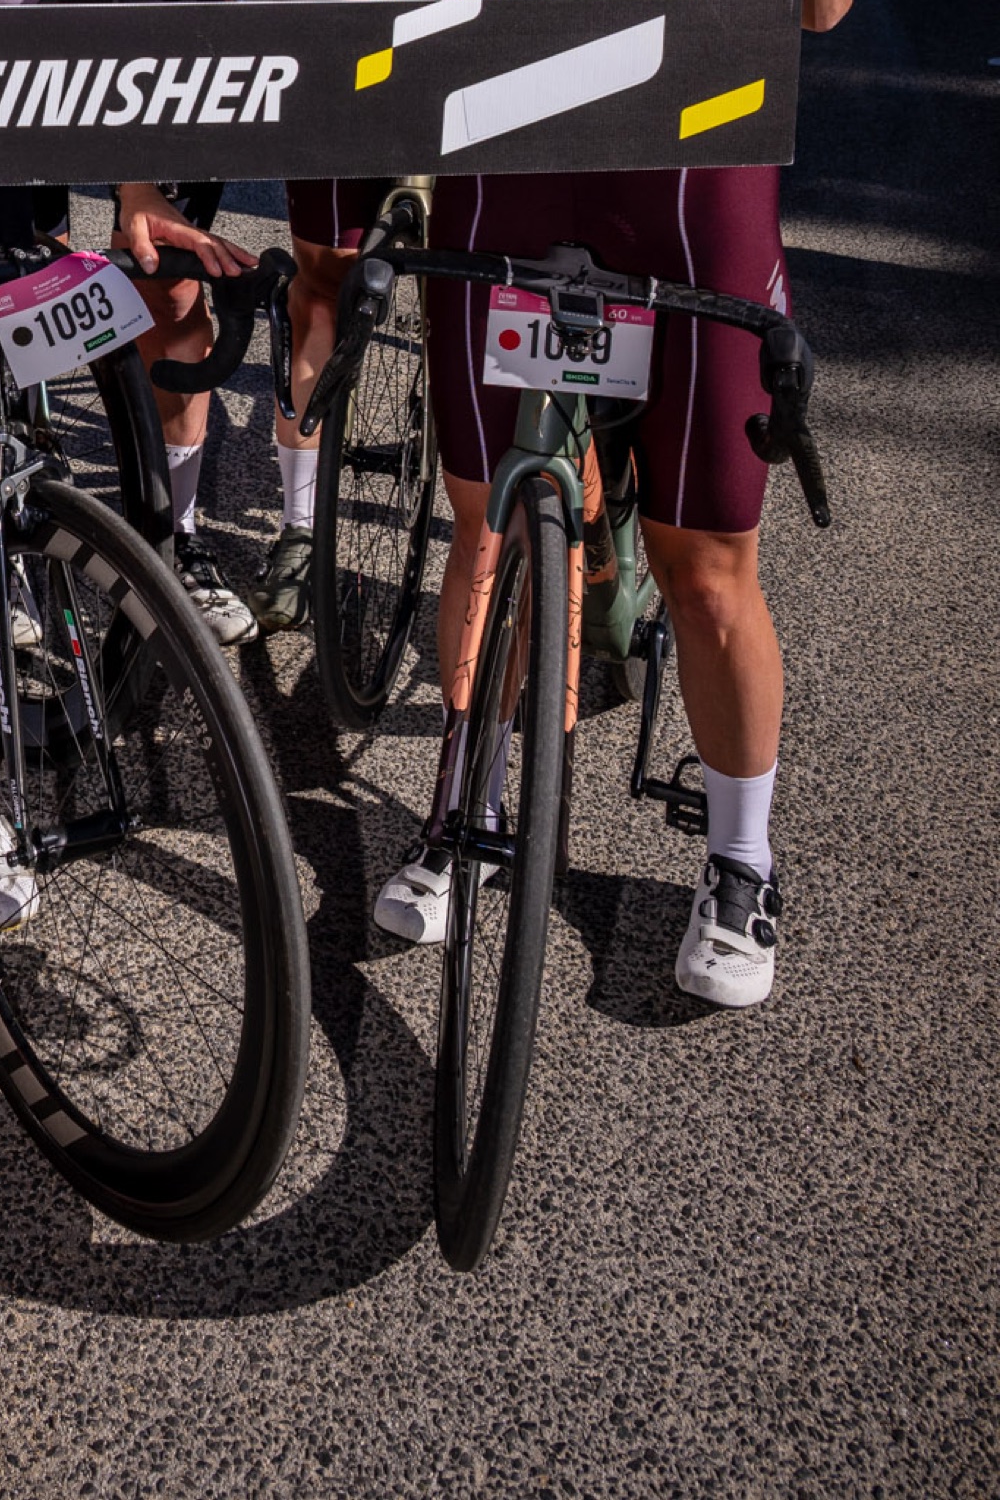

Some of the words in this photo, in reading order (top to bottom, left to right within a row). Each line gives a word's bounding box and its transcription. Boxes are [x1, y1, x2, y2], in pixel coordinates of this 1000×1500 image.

[34, 282, 114, 347] 1093
[608, 309, 627, 320] 60
[75, 656, 104, 740] Bianchi
